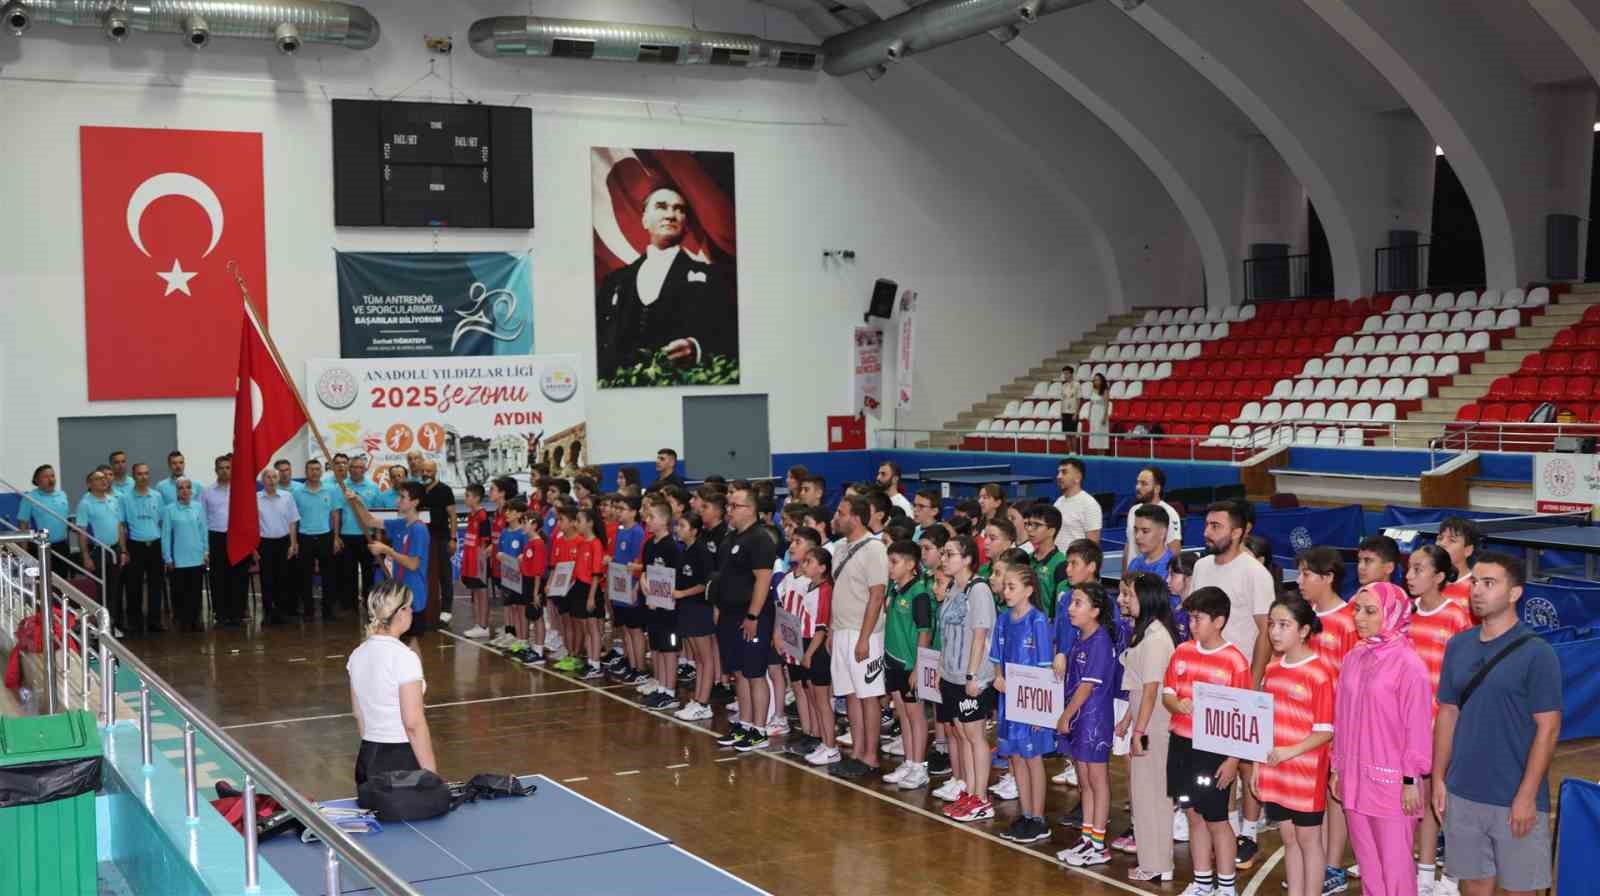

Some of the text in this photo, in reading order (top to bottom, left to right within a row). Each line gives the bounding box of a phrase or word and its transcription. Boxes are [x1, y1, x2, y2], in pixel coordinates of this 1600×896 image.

[363, 294, 434, 304] TÜM ANTRENÖR
[352, 304, 443, 314] VE SPORCULARIMIZA
[355, 315, 442, 327] BAŞARILAR DİLİYORUM
[367, 365, 534, 380] ANADOLU YILDIZLAR LİGİ
[371, 385, 438, 408] 2025
[494, 411, 542, 425] AYDIN
[1016, 684, 1053, 713] AFYON
[1205, 706, 1260, 745] MUĞLA
